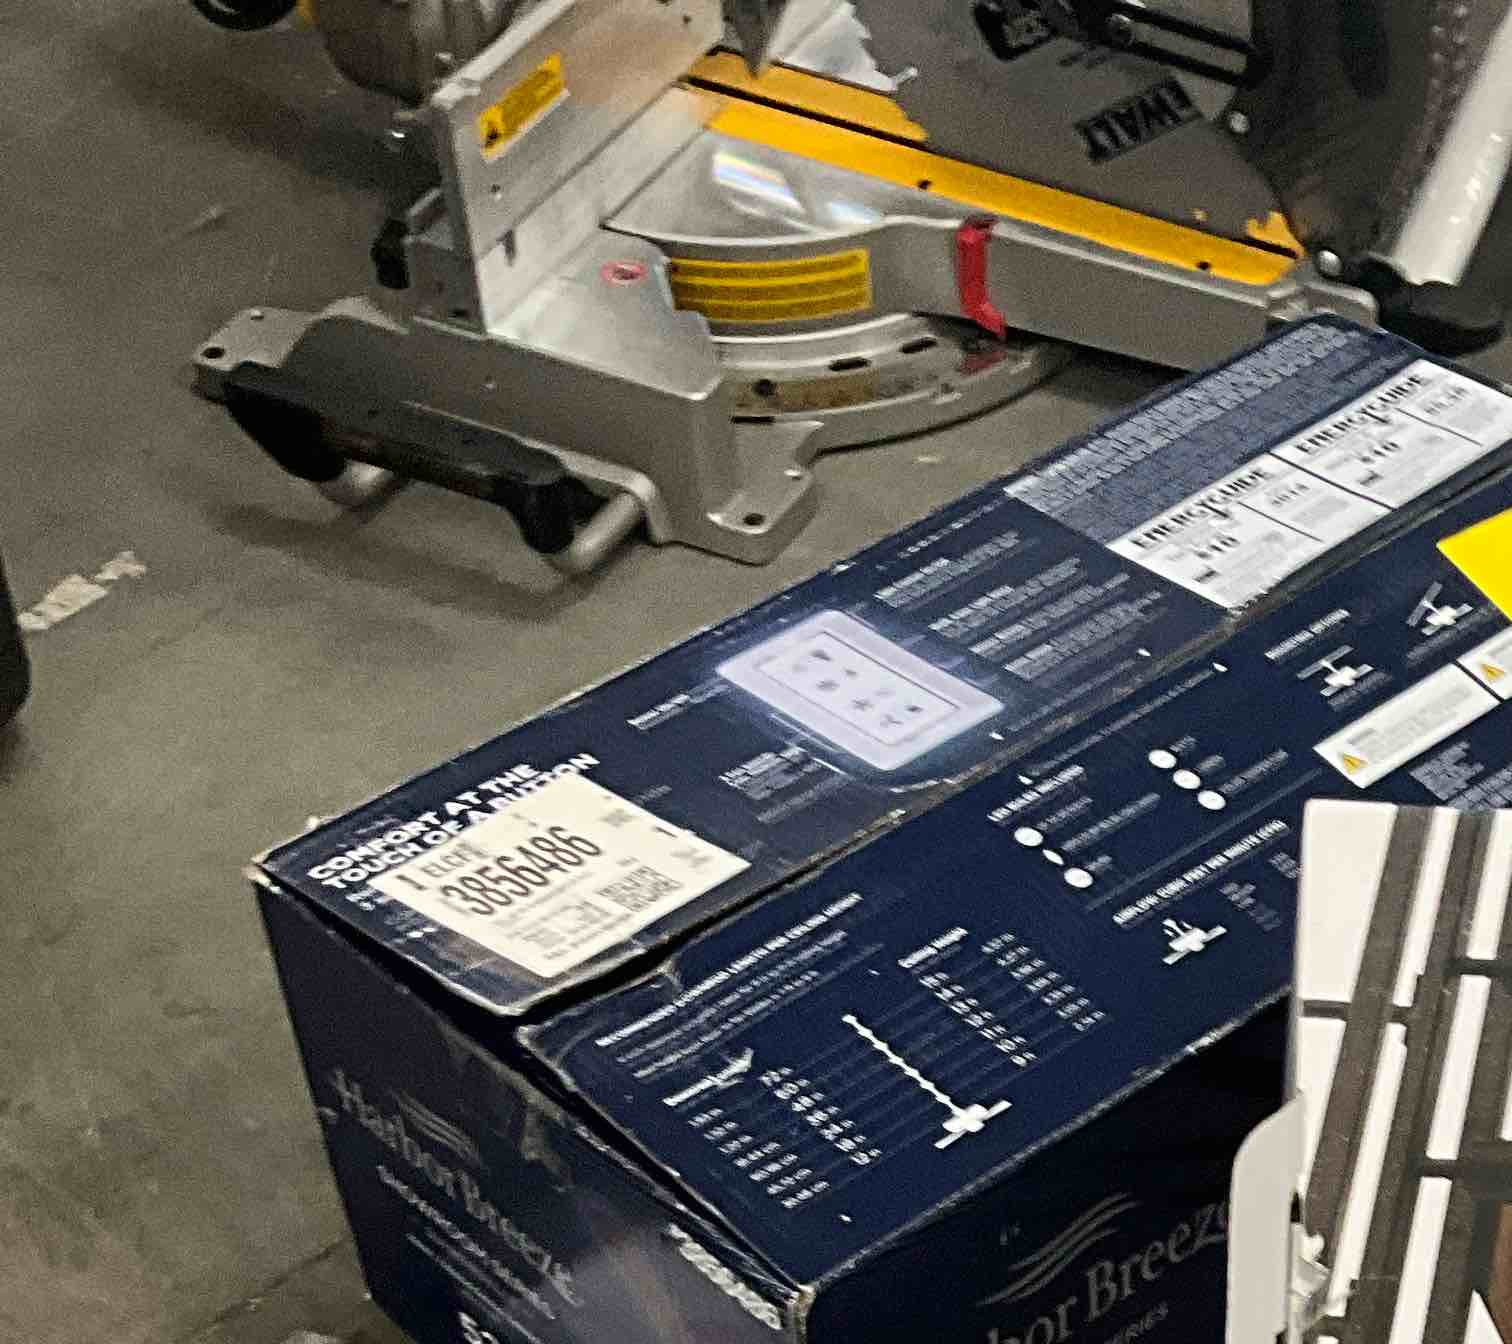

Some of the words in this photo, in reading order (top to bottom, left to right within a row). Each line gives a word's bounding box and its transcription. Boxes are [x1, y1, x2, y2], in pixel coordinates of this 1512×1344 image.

[307, 811, 441, 881] COMFORT
[444, 791, 481, 817] AT
[478, 763, 541, 794] THE
[321, 842, 426, 889] TOUCH
[422, 819, 465, 846] OF
[440, 825, 602, 916] 3856486
[1084, 1202, 1229, 1323] Breez
